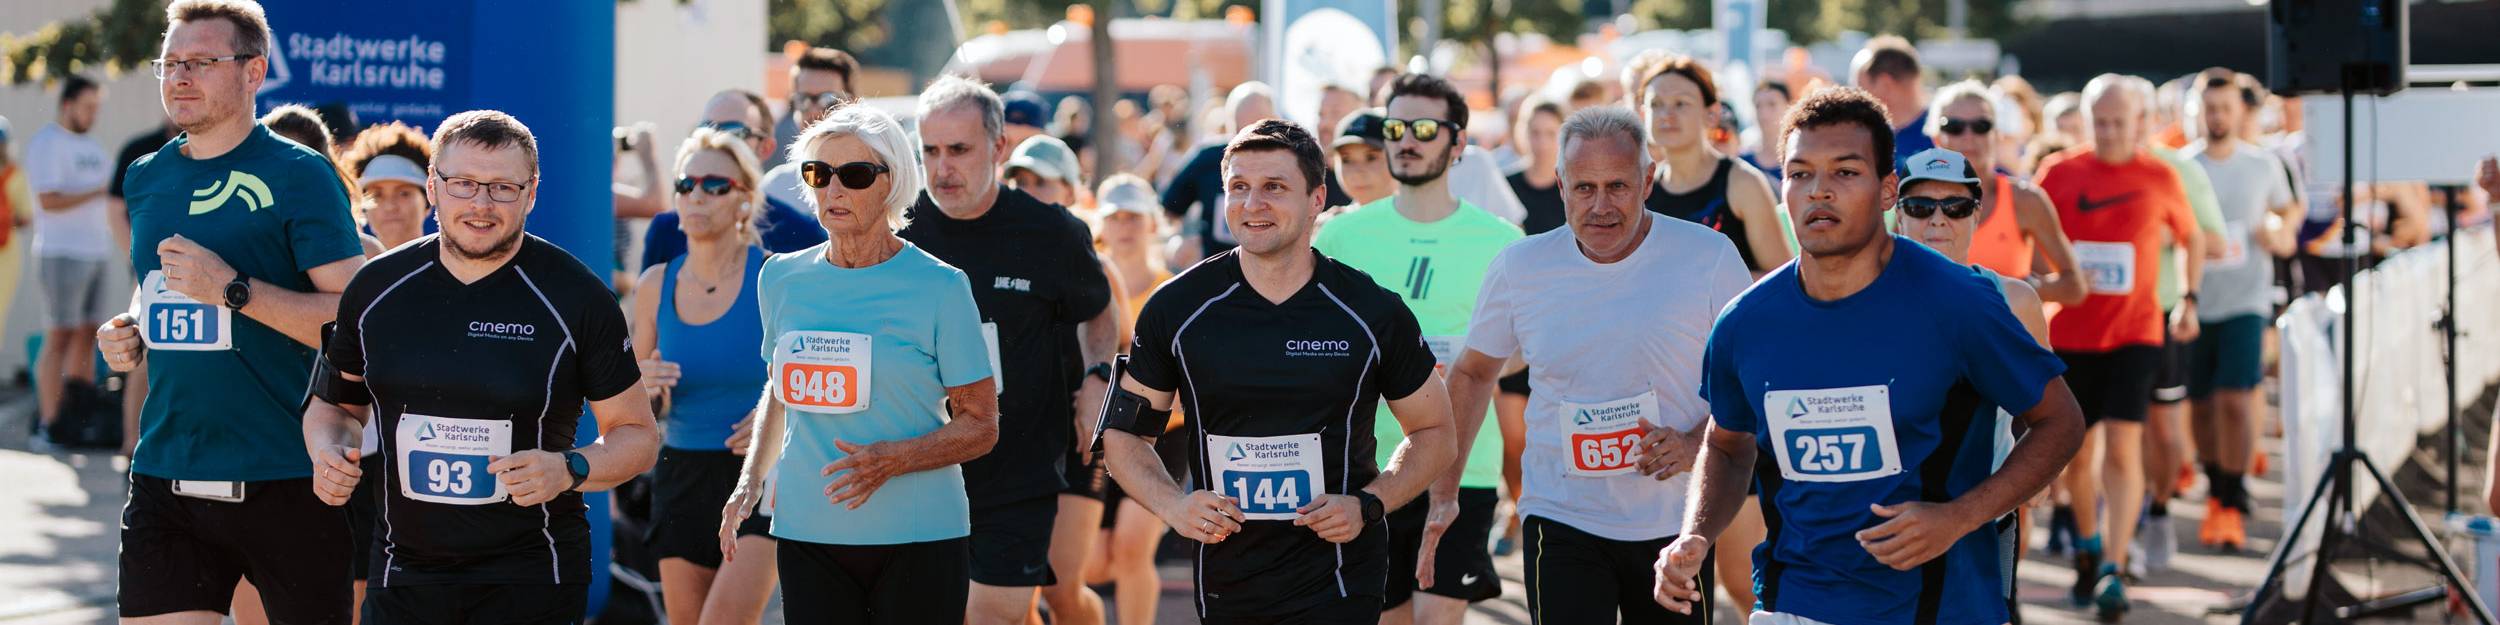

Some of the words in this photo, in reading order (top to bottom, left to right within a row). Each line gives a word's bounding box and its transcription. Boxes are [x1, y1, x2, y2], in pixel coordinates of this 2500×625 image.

[289, 32, 446, 63] Stadtwerke
[311, 60, 445, 89] Karlsruhe
[156, 308, 204, 341] 151
[469, 321, 535, 335] cinemo
[805, 335, 851, 346] Stadtwerke
[1286, 340, 1349, 351] cinemo
[811, 343, 851, 354] Karlsruhe
[789, 368, 846, 404] 948
[1807, 394, 1864, 406] Stadtwerke
[1591, 402, 1641, 416] Stadtwerke
[1818, 403, 1865, 413] Karlsruhe
[1600, 409, 1641, 422] Karlsruhe
[436, 423, 490, 434] Stadtwerke
[444, 432, 490, 442] Karlsruhe
[1246, 441, 1300, 451] Stadtwerke
[1580, 433, 1641, 469] 652
[1796, 433, 1866, 472] 257
[1255, 449, 1300, 459] Karlsruhe
[428, 459, 472, 495] 93
[1233, 477, 1300, 510] 144
